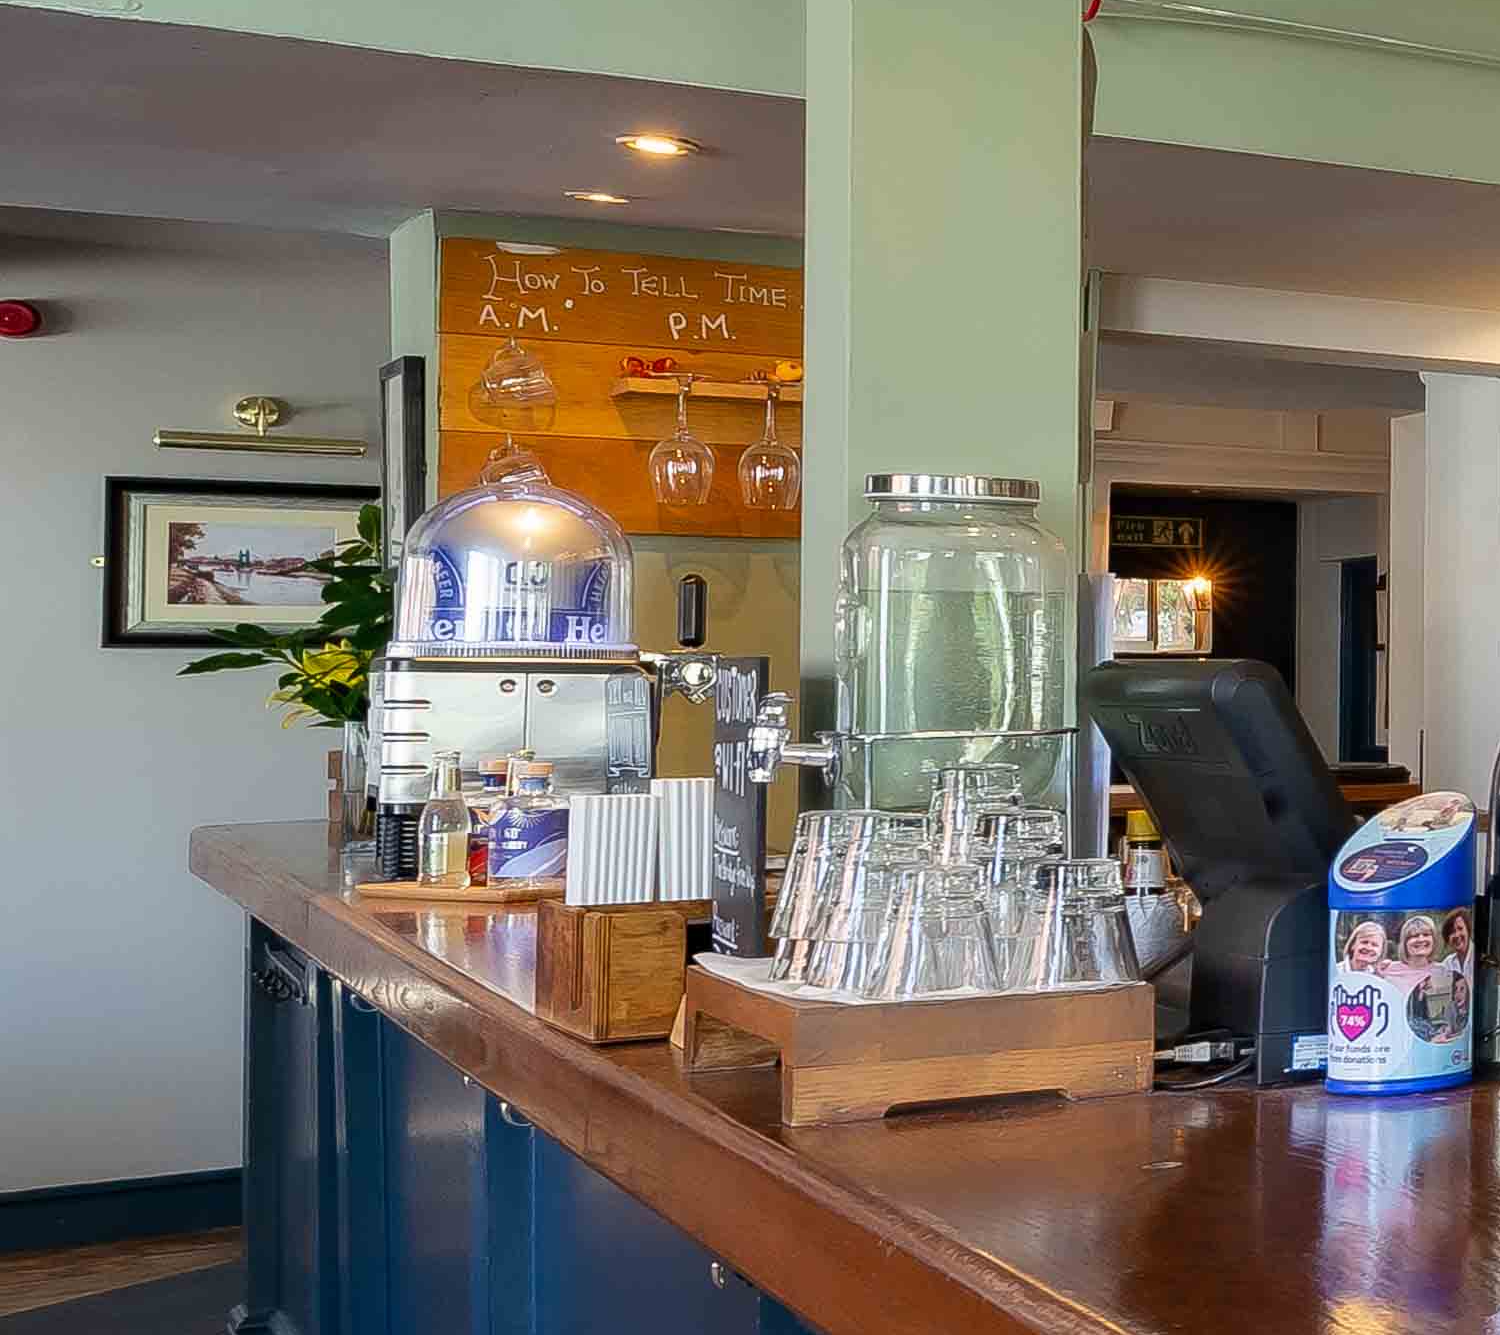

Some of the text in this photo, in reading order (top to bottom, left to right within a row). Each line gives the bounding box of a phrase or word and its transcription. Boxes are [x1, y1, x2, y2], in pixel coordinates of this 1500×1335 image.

[621, 266, 788, 309] TELL TIME
[1340, 1015, 1366, 1026] 74%
